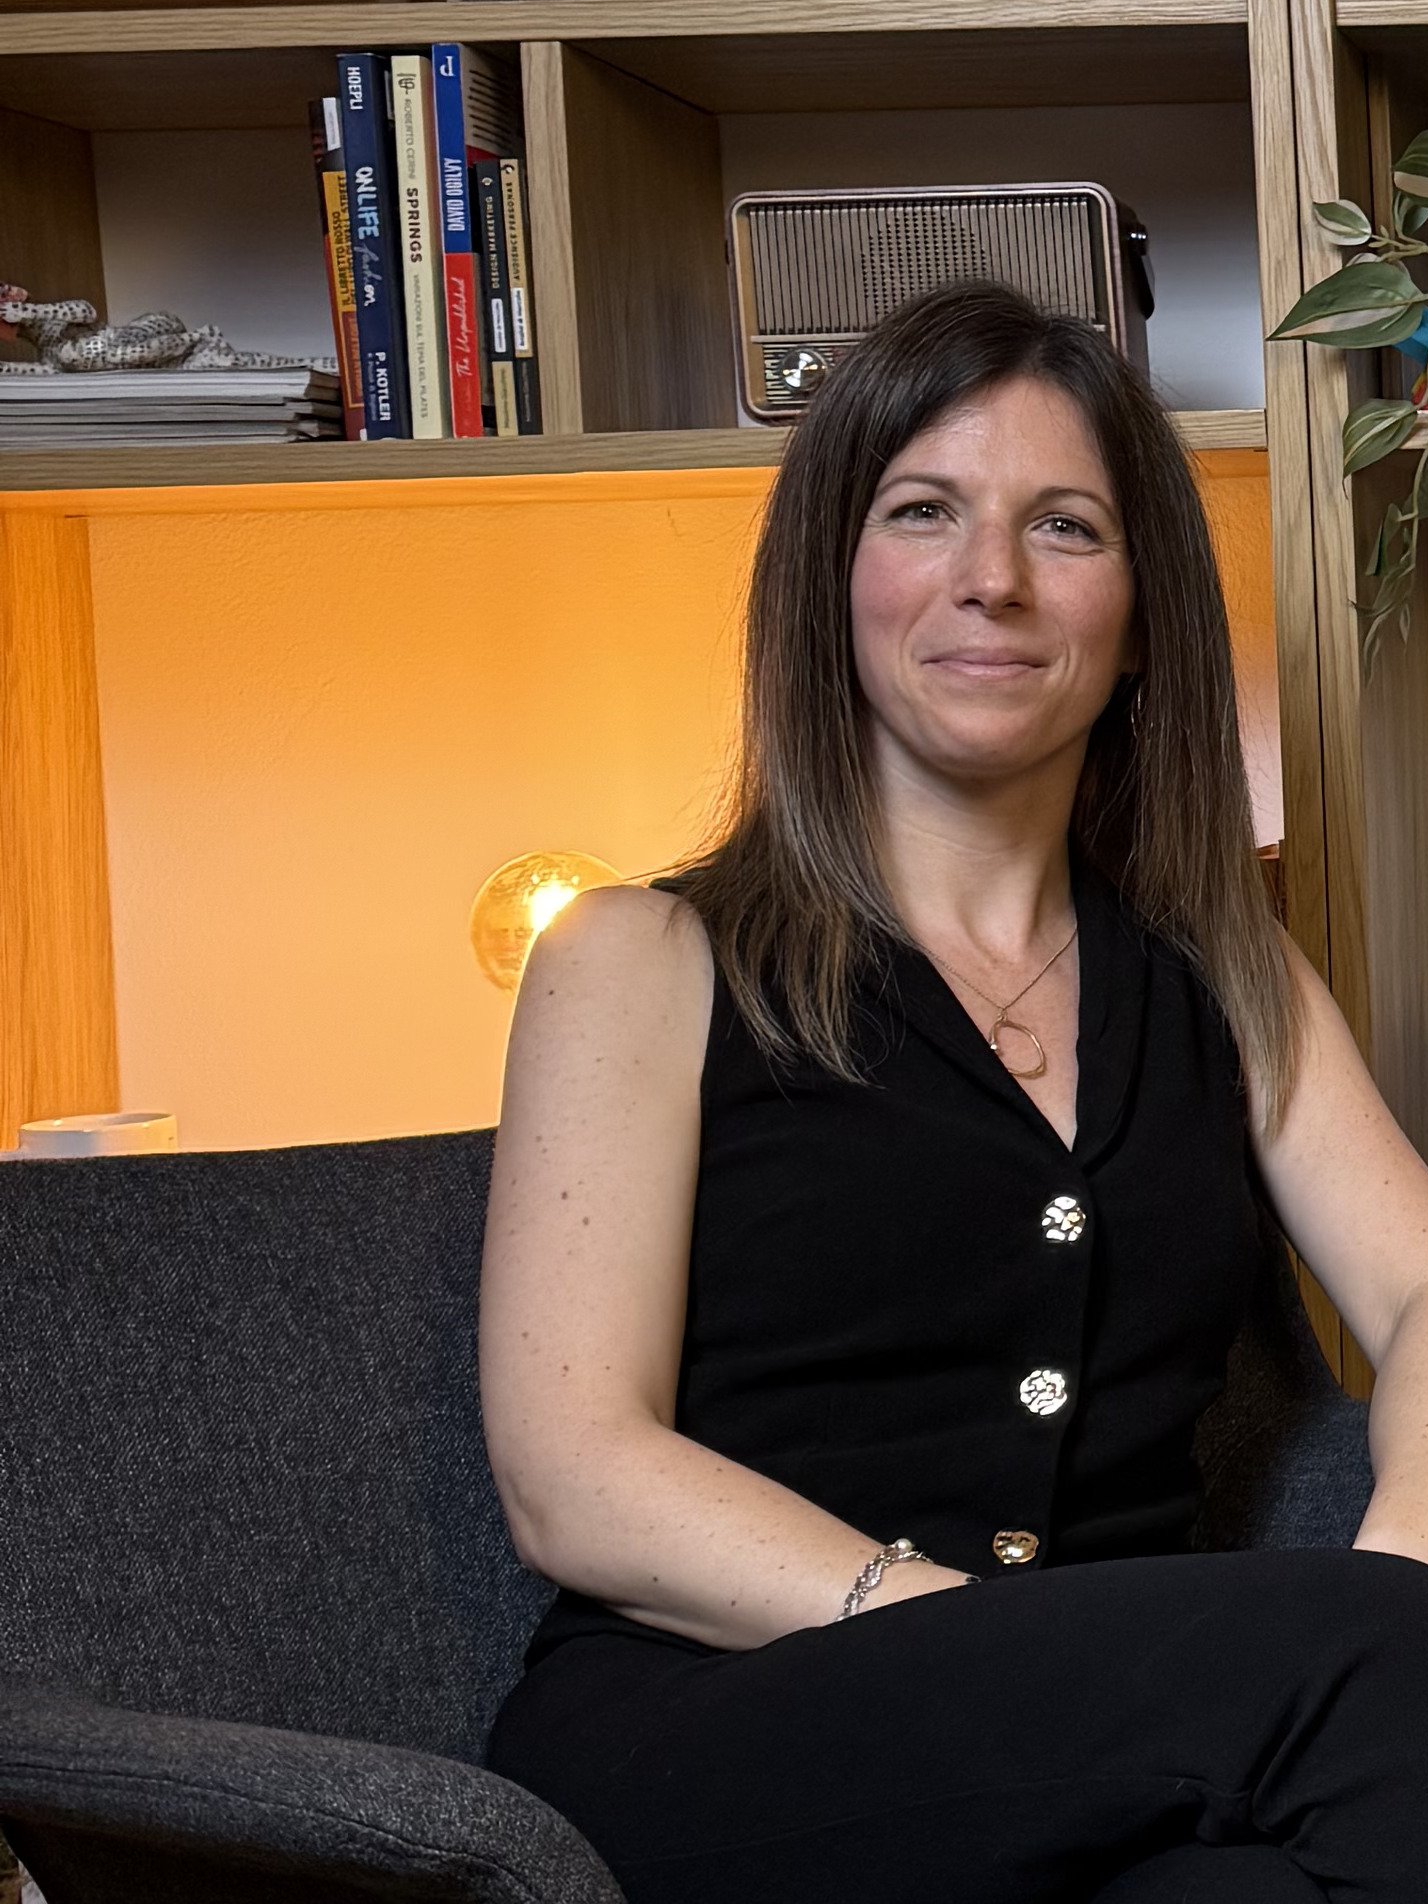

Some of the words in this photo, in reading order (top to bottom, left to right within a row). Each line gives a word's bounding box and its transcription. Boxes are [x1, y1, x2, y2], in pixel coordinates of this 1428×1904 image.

[403, 98, 416, 146] ROBERTO
[346, 65, 363, 111] HOEPLI
[355, 166, 380, 240] ONLIFE
[336, 174, 348, 214] STREET
[444, 157, 464, 196] OGILVY
[407, 187, 423, 264] SPRINGS
[447, 198, 466, 231] DAVID
[485, 195, 497, 252] MARKETING
[505, 180, 517, 231] PERSONAS
[332, 211, 344, 245] ROSSO
[336, 246, 349, 295] LIBRETTO
[489, 253, 500, 289] DESIGN
[510, 233, 521, 282] AUDIENCE
[341, 296, 350, 306] IL
[412, 274, 422, 322] VARIAZIONI
[374, 351, 387, 362] P.
[416, 341, 425, 364] TEMA
[456, 357, 474, 378] The
[375, 367, 391, 421] KOTLER
[419, 385, 429, 419] PILATES
